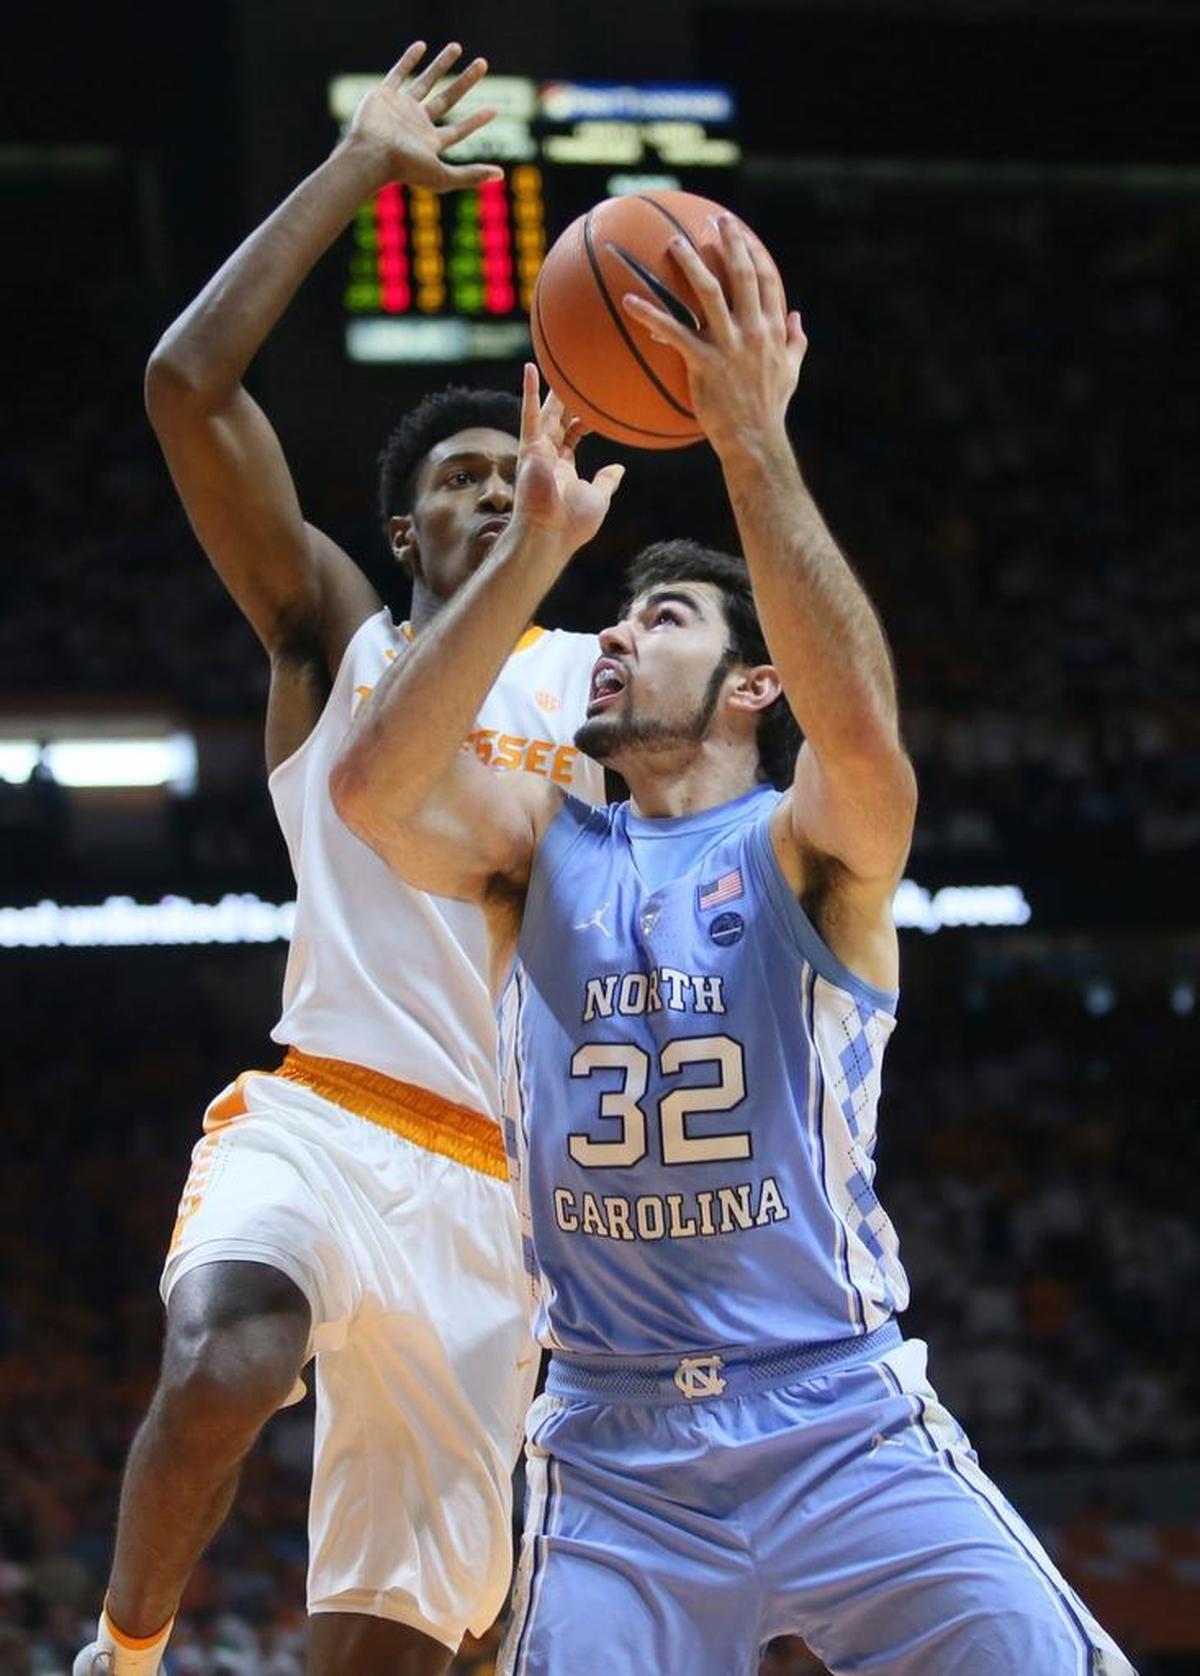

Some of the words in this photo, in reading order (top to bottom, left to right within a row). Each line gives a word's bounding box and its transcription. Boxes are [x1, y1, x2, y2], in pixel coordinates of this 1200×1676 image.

[583, 966, 727, 1023] NORTH
[567, 1033, 753, 1169] 32
[553, 1177, 789, 1241] CAROLINA
